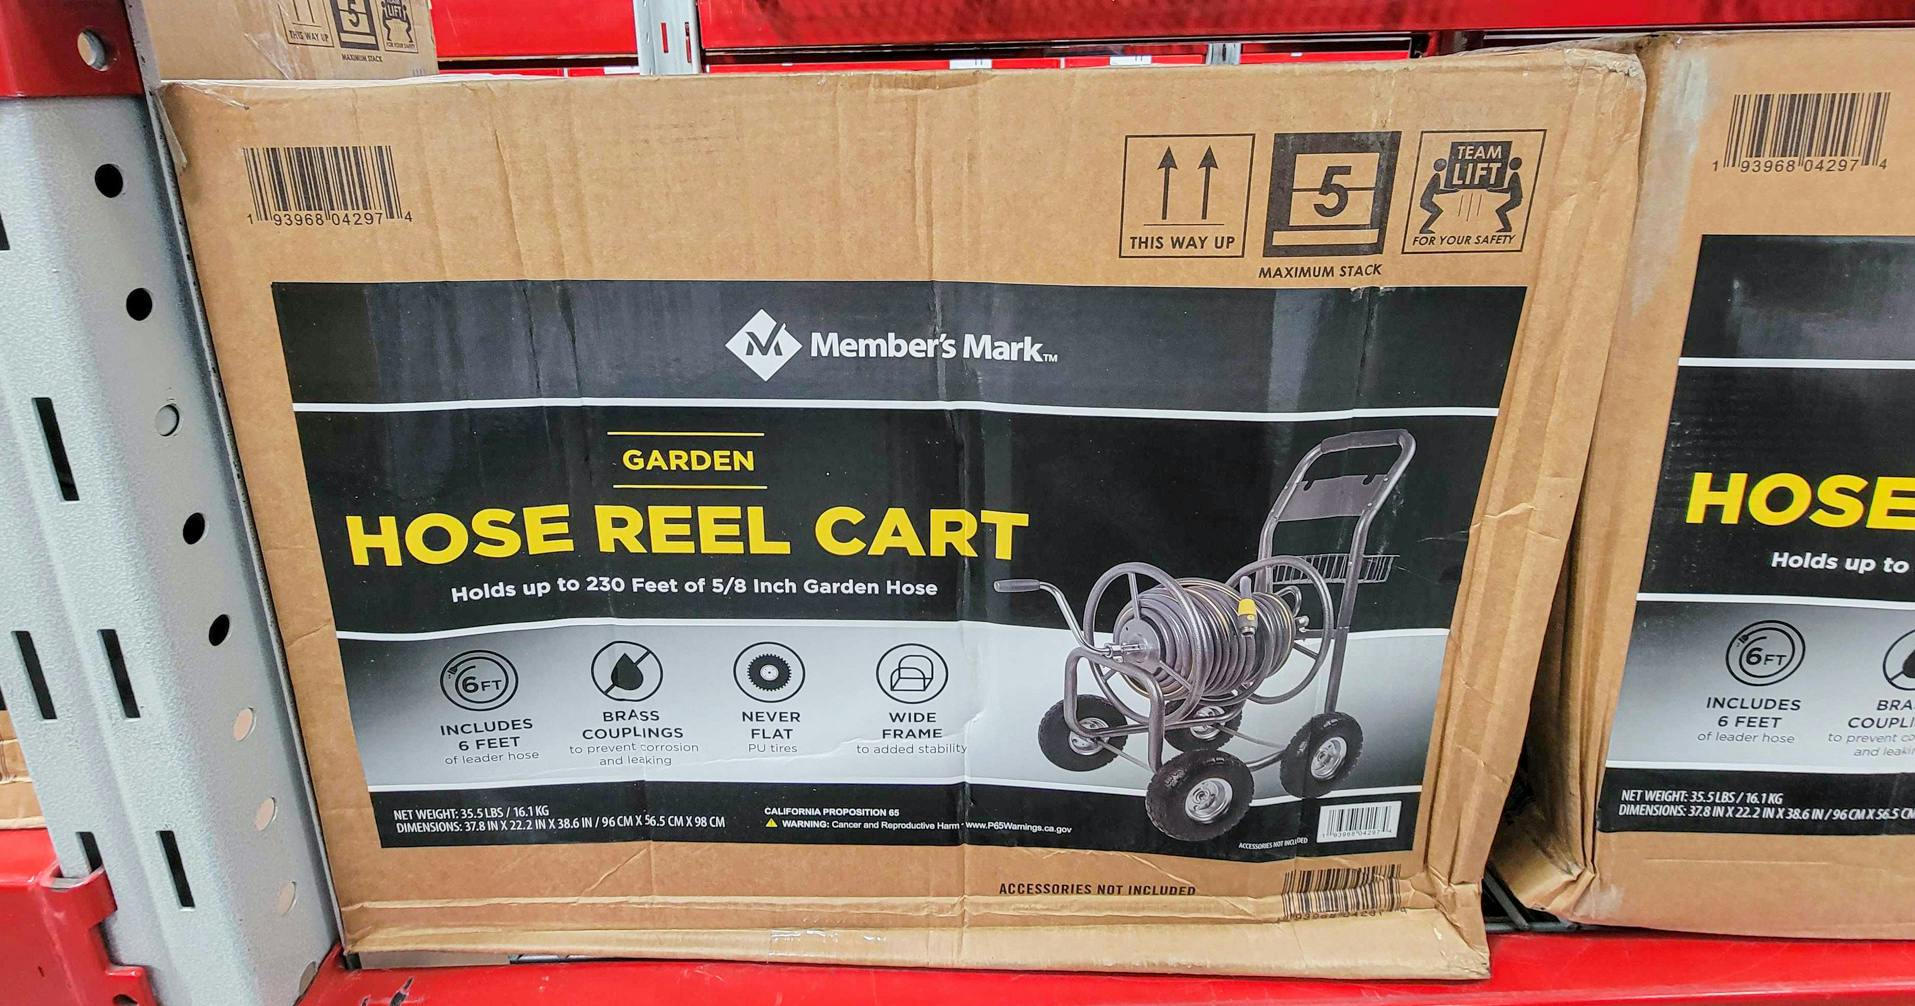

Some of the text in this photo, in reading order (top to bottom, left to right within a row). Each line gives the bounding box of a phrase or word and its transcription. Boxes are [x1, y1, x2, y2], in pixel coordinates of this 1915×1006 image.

[304, 31, 320, 41] WAY
[320, 33, 329, 42] UP
[342, 54, 383, 63] MAXIMUM STACK
[1457, 145, 1502, 160] TEAM
[1712, 158, 1888, 172] 1 93968 04297 4
[1452, 162, 1502, 185] LIFT
[1314, 165, 1352, 217] 5
[247, 211, 413, 226] 1 93968 04297 4
[1130, 236, 1235, 249] THIS WAY UP
[1412, 234, 1516, 246] FOR YOUR SAFETY
[1258, 263, 1383, 279] MAXIMUM STACK
[810, 332, 957, 359] Member's
[622, 449, 755, 472] GARDEN
[1685, 472, 1915, 531] HOSE
[345, 504, 1030, 567] HOSE REEL CART
[1771, 551, 1910, 574] Holds up to
[451, 576, 938, 603] Holds up to 230 Feet of 5/8 Inch Garden Hose
[1706, 696, 1802, 711] INCLUDES
[1876, 699, 1915, 711] BRA
[602, 709, 660, 722] BRASS
[742, 711, 801, 722] NEVER
[889, 712, 936, 723] WIDE
[1718, 716, 1782, 729] 6 FEET
[440, 718, 533, 736] INCLUDES
[582, 726, 684, 740] COUPLINGS
[751, 728, 794, 739] FLAT
[882, 728, 943, 739] FRAME
[458, 736, 521, 751] 6 FEET
[1697, 731, 1795, 743] of leader hose
[1828, 733, 1842, 742] to
[1846, 733, 1897, 744] prevent
[569, 743, 699, 756] to prevent corrosion
[748, 743, 798, 753] PU tires
[857, 743, 968, 755] to added stability
[1854, 747, 1879, 757] and
[445, 750, 539, 765] of leader hose
[600, 755, 672, 767] and leaking
[1621, 789, 1643, 801] NET
[1644, 790, 1688, 802] WEIGHT:
[1690, 790, 1715, 803] 35.5
[1715, 791, 1736, 803] LBS
[1746, 792, 1767, 804] 16.1
[1767, 793, 1784, 805] KG
[393, 809, 414, 821] NET
[415, 808, 459, 820] WEIGHT:
[461, 808, 483, 819] 35.5
[484, 807, 504, 818] LBS
[513, 806, 533, 818] 16.1
[535, 805, 550, 816] KG
[764, 807, 900, 817] CALIFORNIA PROPOSITION 65
[1618, 804, 1687, 817] DIMENSIONS:
[1688, 805, 1711, 817] 37.8
[1712, 805, 1725, 818] IN
[1725, 806, 1735, 818] X
[1735, 806, 1761, 818] 22.2
[1762, 807, 1775, 819] IN
[1776, 807, 1785, 819] X
[1785, 808, 1810, 820] 38.6
[1811, 808, 1825, 820] IN
[1832, 808, 1848, 820] 96
[1848, 808, 1866, 820] CM
[1866, 808, 1876, 820] X
[396, 821, 462, 833] DIMENSIONS:
[465, 821, 486, 832] 37.8
[487, 820, 498, 831] IN
[501, 820, 508, 831] X
[510, 819, 533, 831] 22.2
[535, 818, 546, 830] IN
[549, 818, 556, 829] X
[558, 817, 580, 829] 38.6
[582, 816, 593, 828] IN
[602, 816, 615, 828] 96
[616, 815, 633, 827] CM
[635, 815, 643, 826] X
[644, 814, 666, 827] 56.5
[668, 815, 684, 827] CM
[686, 815, 693, 827] X
[695, 816, 708, 828] 98
[709, 816, 726, 828] CM
[782, 820, 830, 829] WARNING:
[832, 820, 861, 829] Cancer
[864, 821, 879, 829] and
[881, 820, 936, 831] Reproductive
[937, 821, 960, 830] Harm
[965, 821, 1072, 835] www.P65Warnings.ca.gov
[1273, 840, 1284, 848] NOT
[999, 882, 1197, 896] ACCESSORIES NOT INCLUDED
